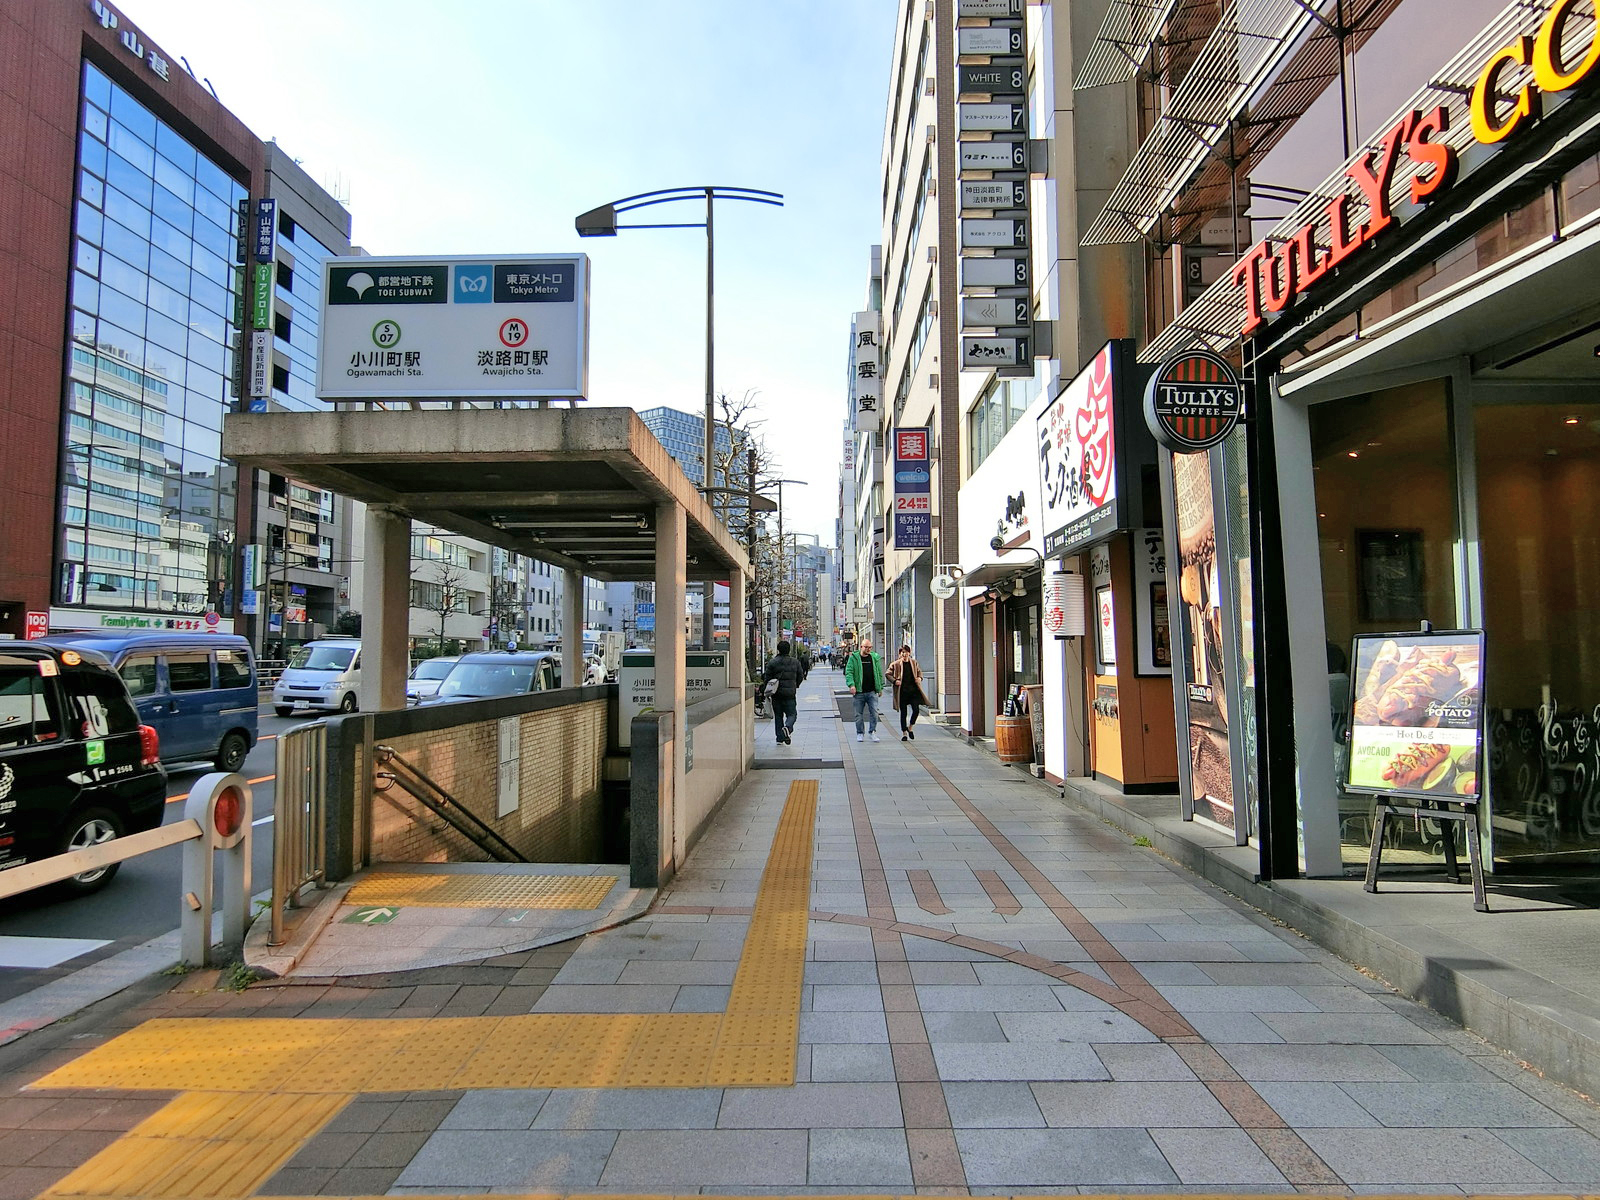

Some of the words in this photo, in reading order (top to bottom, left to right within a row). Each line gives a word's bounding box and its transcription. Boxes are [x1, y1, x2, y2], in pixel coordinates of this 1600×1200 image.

[1011, 33, 1021, 49] 9
[968, 73, 1001, 82] WHITE
[1011, 71, 1022, 88] 8
[1012, 109, 1023, 126] 7
[1013, 148, 1024, 165] 6
[972, 195, 1011, 203] 法律事務所
[1014, 186, 1025, 203] 5
[1233, 106, 1457, 335] TULLY'S
[259, 216, 272, 255] 山甚物産
[1015, 224, 1026, 242] 4
[1017, 264, 1027, 281] 3
[378, 275, 434, 287] 都営地下鉄
[506, 273, 563, 285] 東京メトロ
[378, 289, 396, 297] TOEI
[399, 288, 434, 297] SUBWAY
[509, 286, 534, 296] Tokyo
[534, 286, 559, 294] Metro
[1016, 303, 1027, 320] 2
[384, 324, 390, 333] S
[509, 323, 519, 332] M
[379, 333, 394, 343] 07
[508, 332, 521, 342] 19
[1019, 342, 1026, 361] 1
[350, 351, 421, 368] 小川町駅
[477, 350, 549, 367] 淡路町駅
[346, 368, 405, 379] Ogawamachi
[407, 368, 424, 376] Sta.
[482, 367, 525, 378] Awajicho
[527, 366, 544, 376] Sta.
[857, 330, 878, 413] 風雲堂
[1160, 386, 1234, 406] TULLY'S
[1173, 407, 1220, 416] COFFEE
[901, 436, 922, 457] 薬
[897, 497, 916, 510] 24
[899, 515, 927, 525] 処方せん
[905, 525, 920, 534] 受付
[29, 615, 47, 626] 100
[101, 614, 151, 628] FamilyMart
[1428, 708, 1472, 717] POTATO
[1397, 730, 1414, 739] Hot
[1416, 730, 1434, 740] Dog
[1357, 745, 1391, 757] AVOCADO
